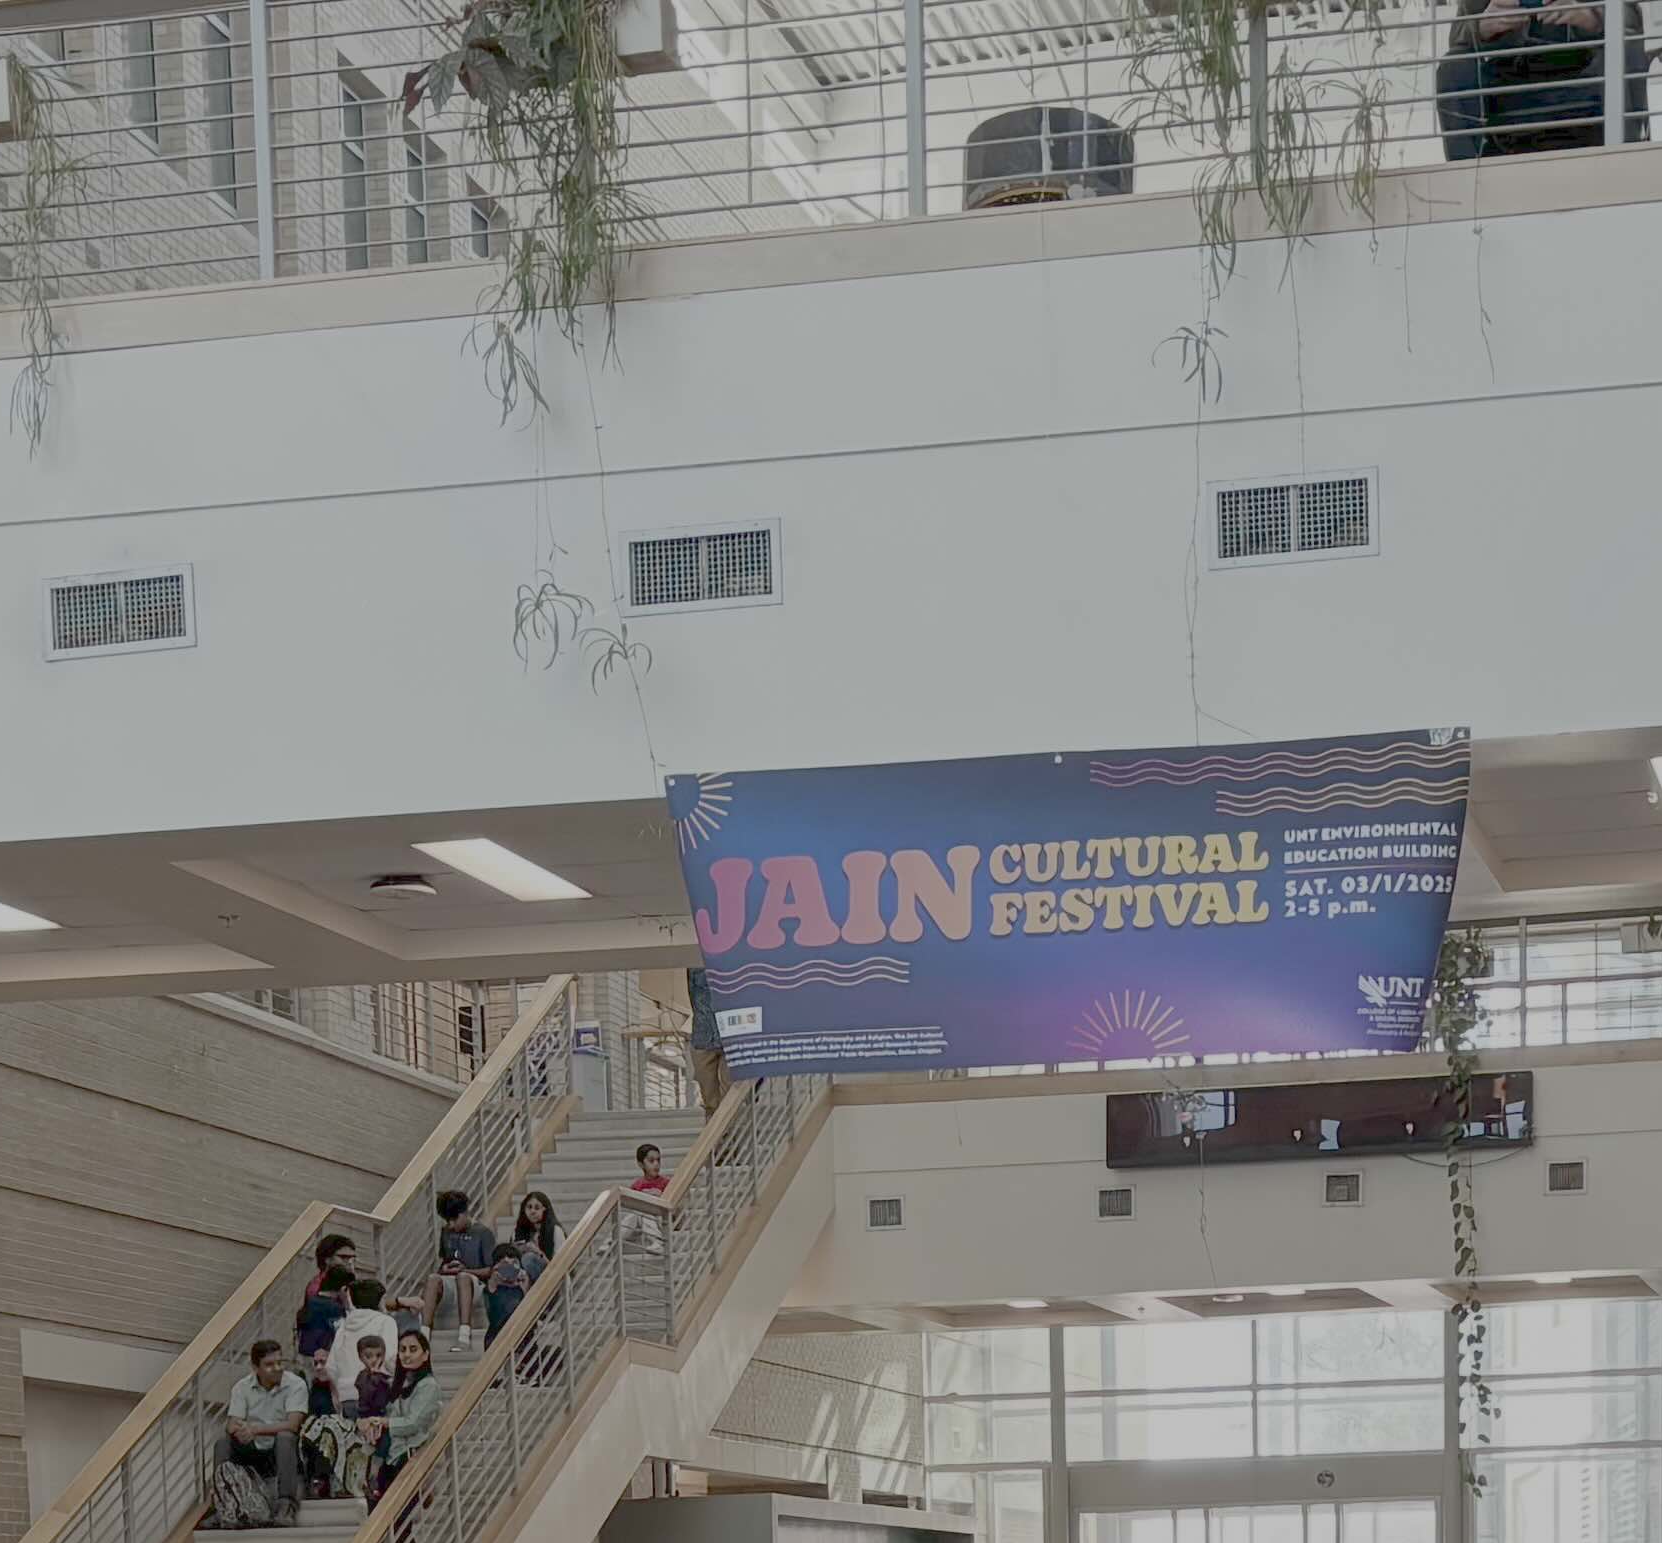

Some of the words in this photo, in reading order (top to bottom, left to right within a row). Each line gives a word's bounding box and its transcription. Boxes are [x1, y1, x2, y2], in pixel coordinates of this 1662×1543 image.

[1283, 828, 1318, 844] UNT
[1321, 822, 1458, 841] ENVIRONMENTAL
[989, 831, 1270, 885] CULTURAL
[1283, 846, 1378, 865] EDUCATION
[1382, 844, 1457, 859] BUILDING
[1284, 877, 1334, 898] SAT.
[1341, 872, 1453, 894] 03/1/2025
[695, 844, 981, 955] JAIN
[989, 879, 1270, 936] FESTIVAL
[1284, 898, 1321, 918] 2-5
[1327, 899, 1376, 919] p.m.
[1378, 976, 1424, 998] UNT
